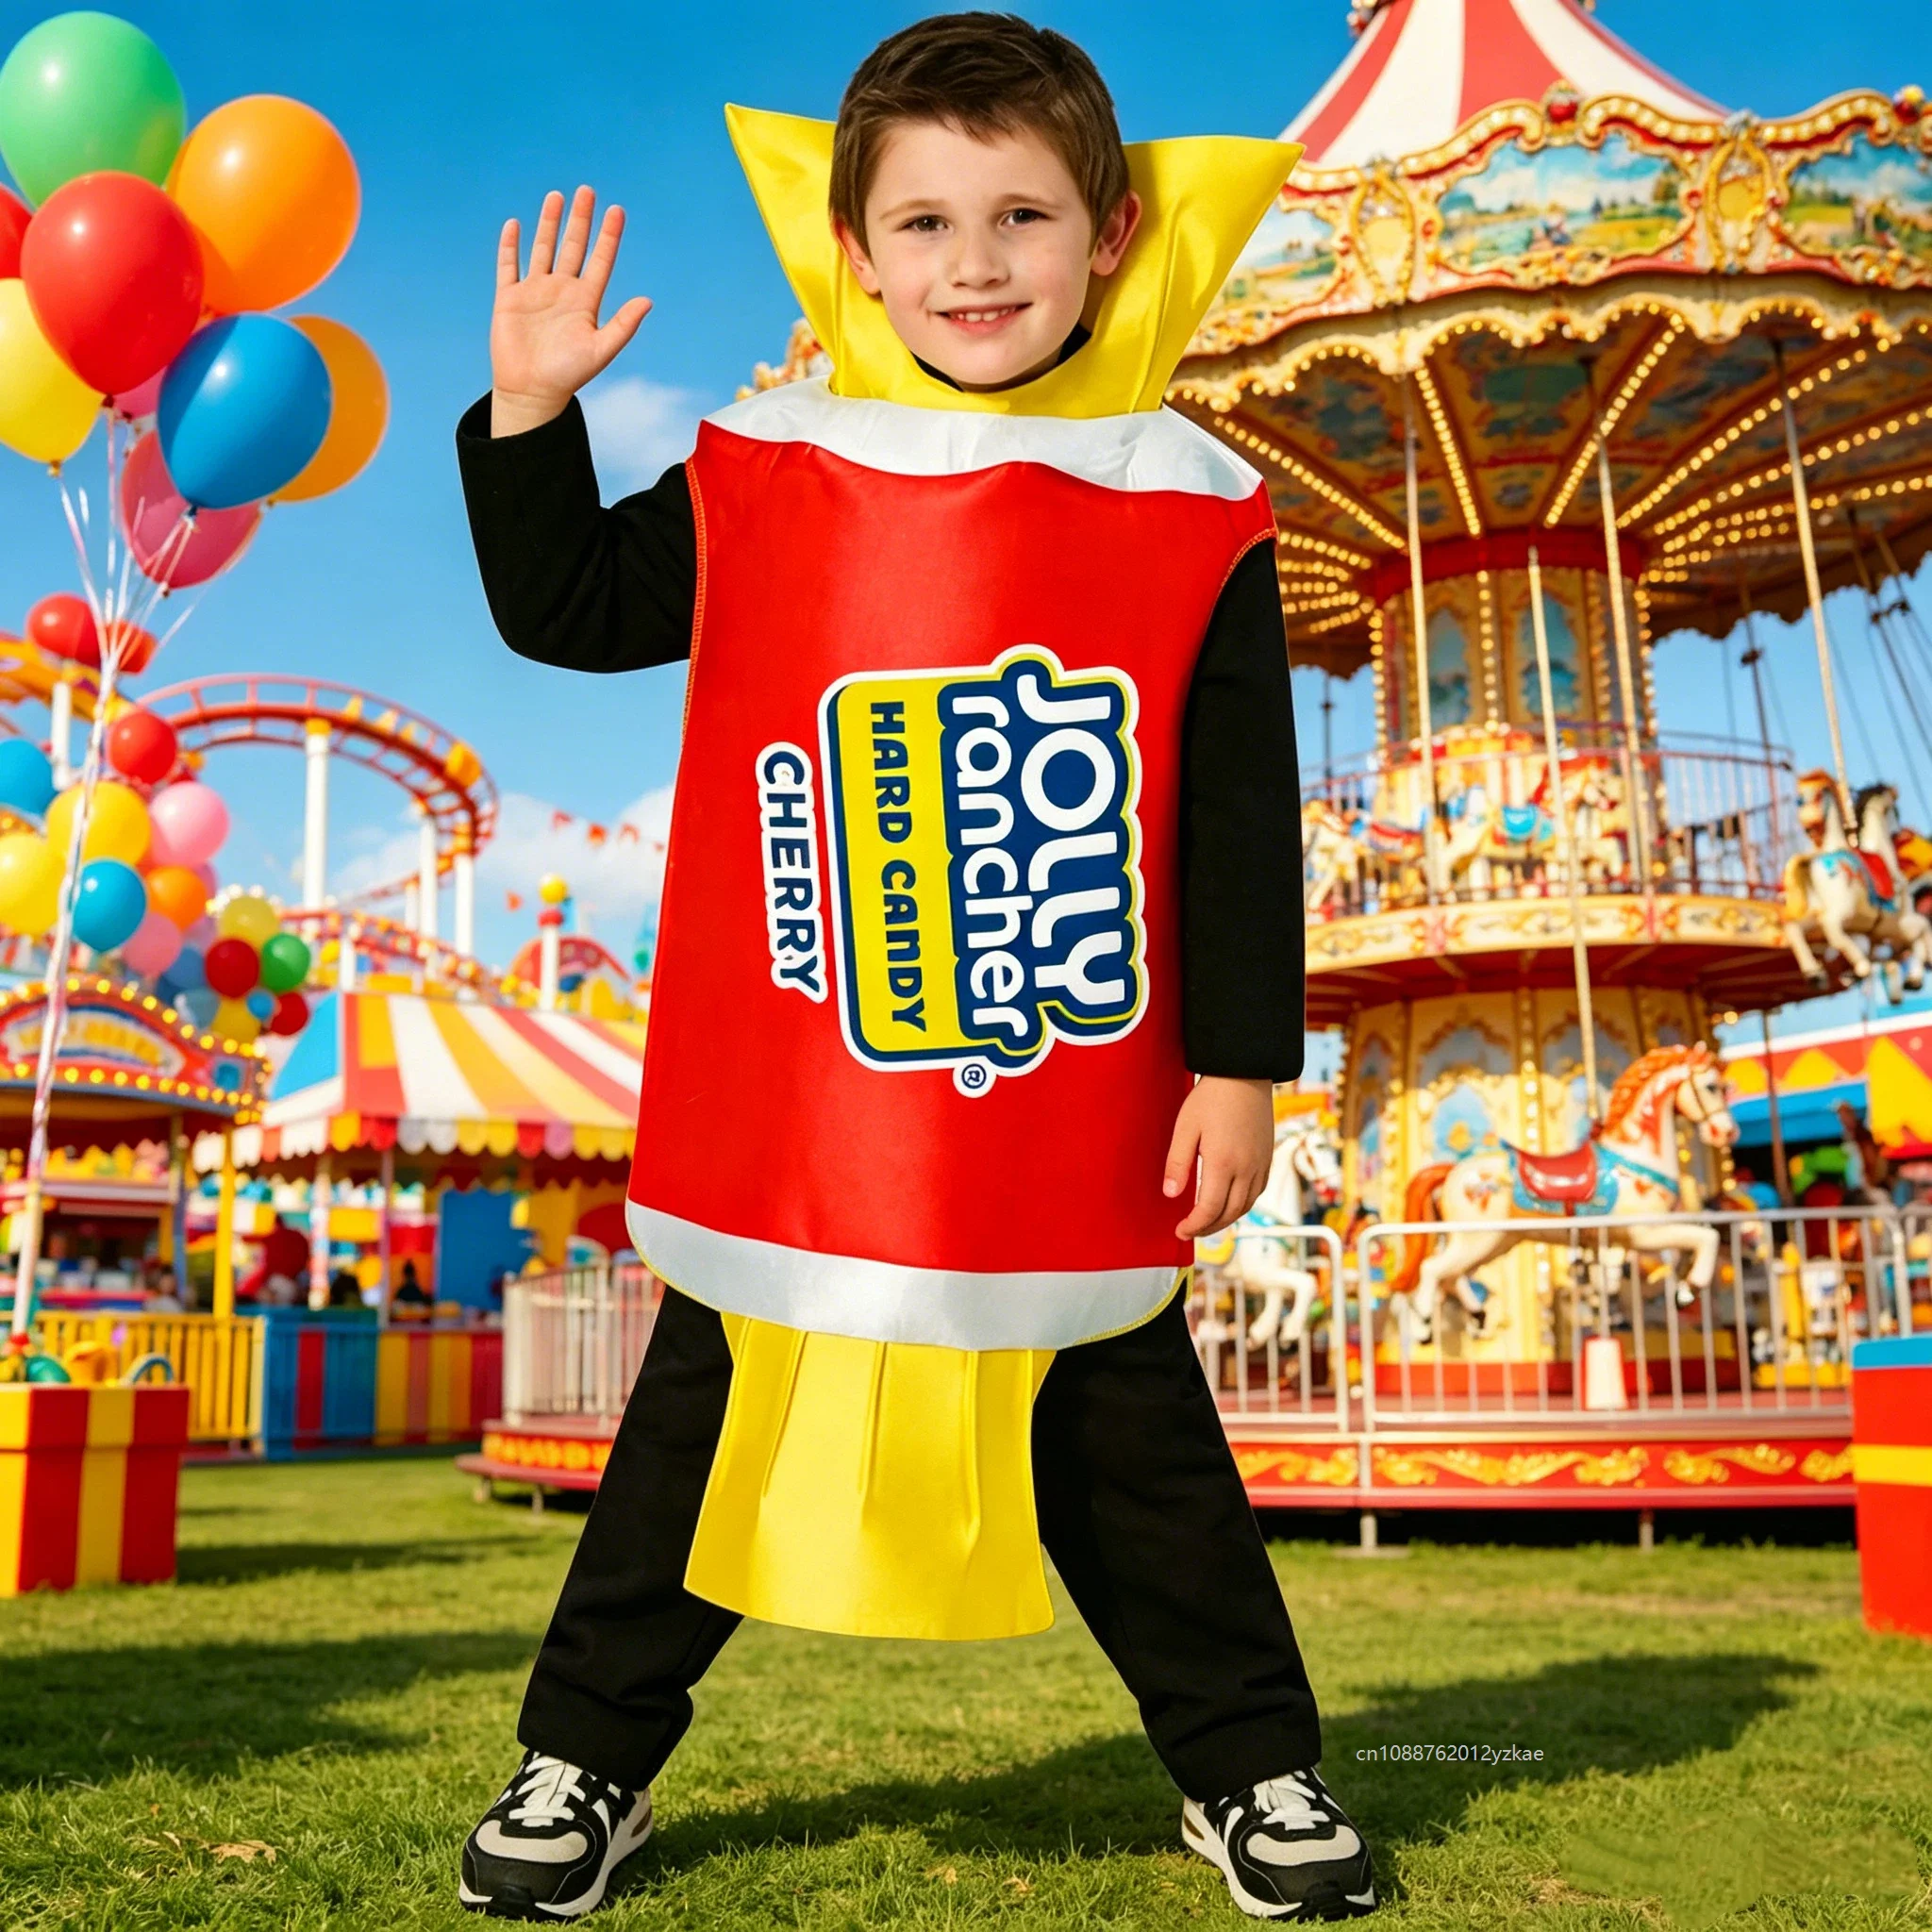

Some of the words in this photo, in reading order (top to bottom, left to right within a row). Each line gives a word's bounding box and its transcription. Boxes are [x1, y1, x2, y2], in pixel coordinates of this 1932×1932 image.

[763, 750, 821, 993] CHERRY
[870, 701, 912, 844] HARD
[952, 695, 1034, 1037] rancher
[1017, 674, 1125, 1005] JOLLY
